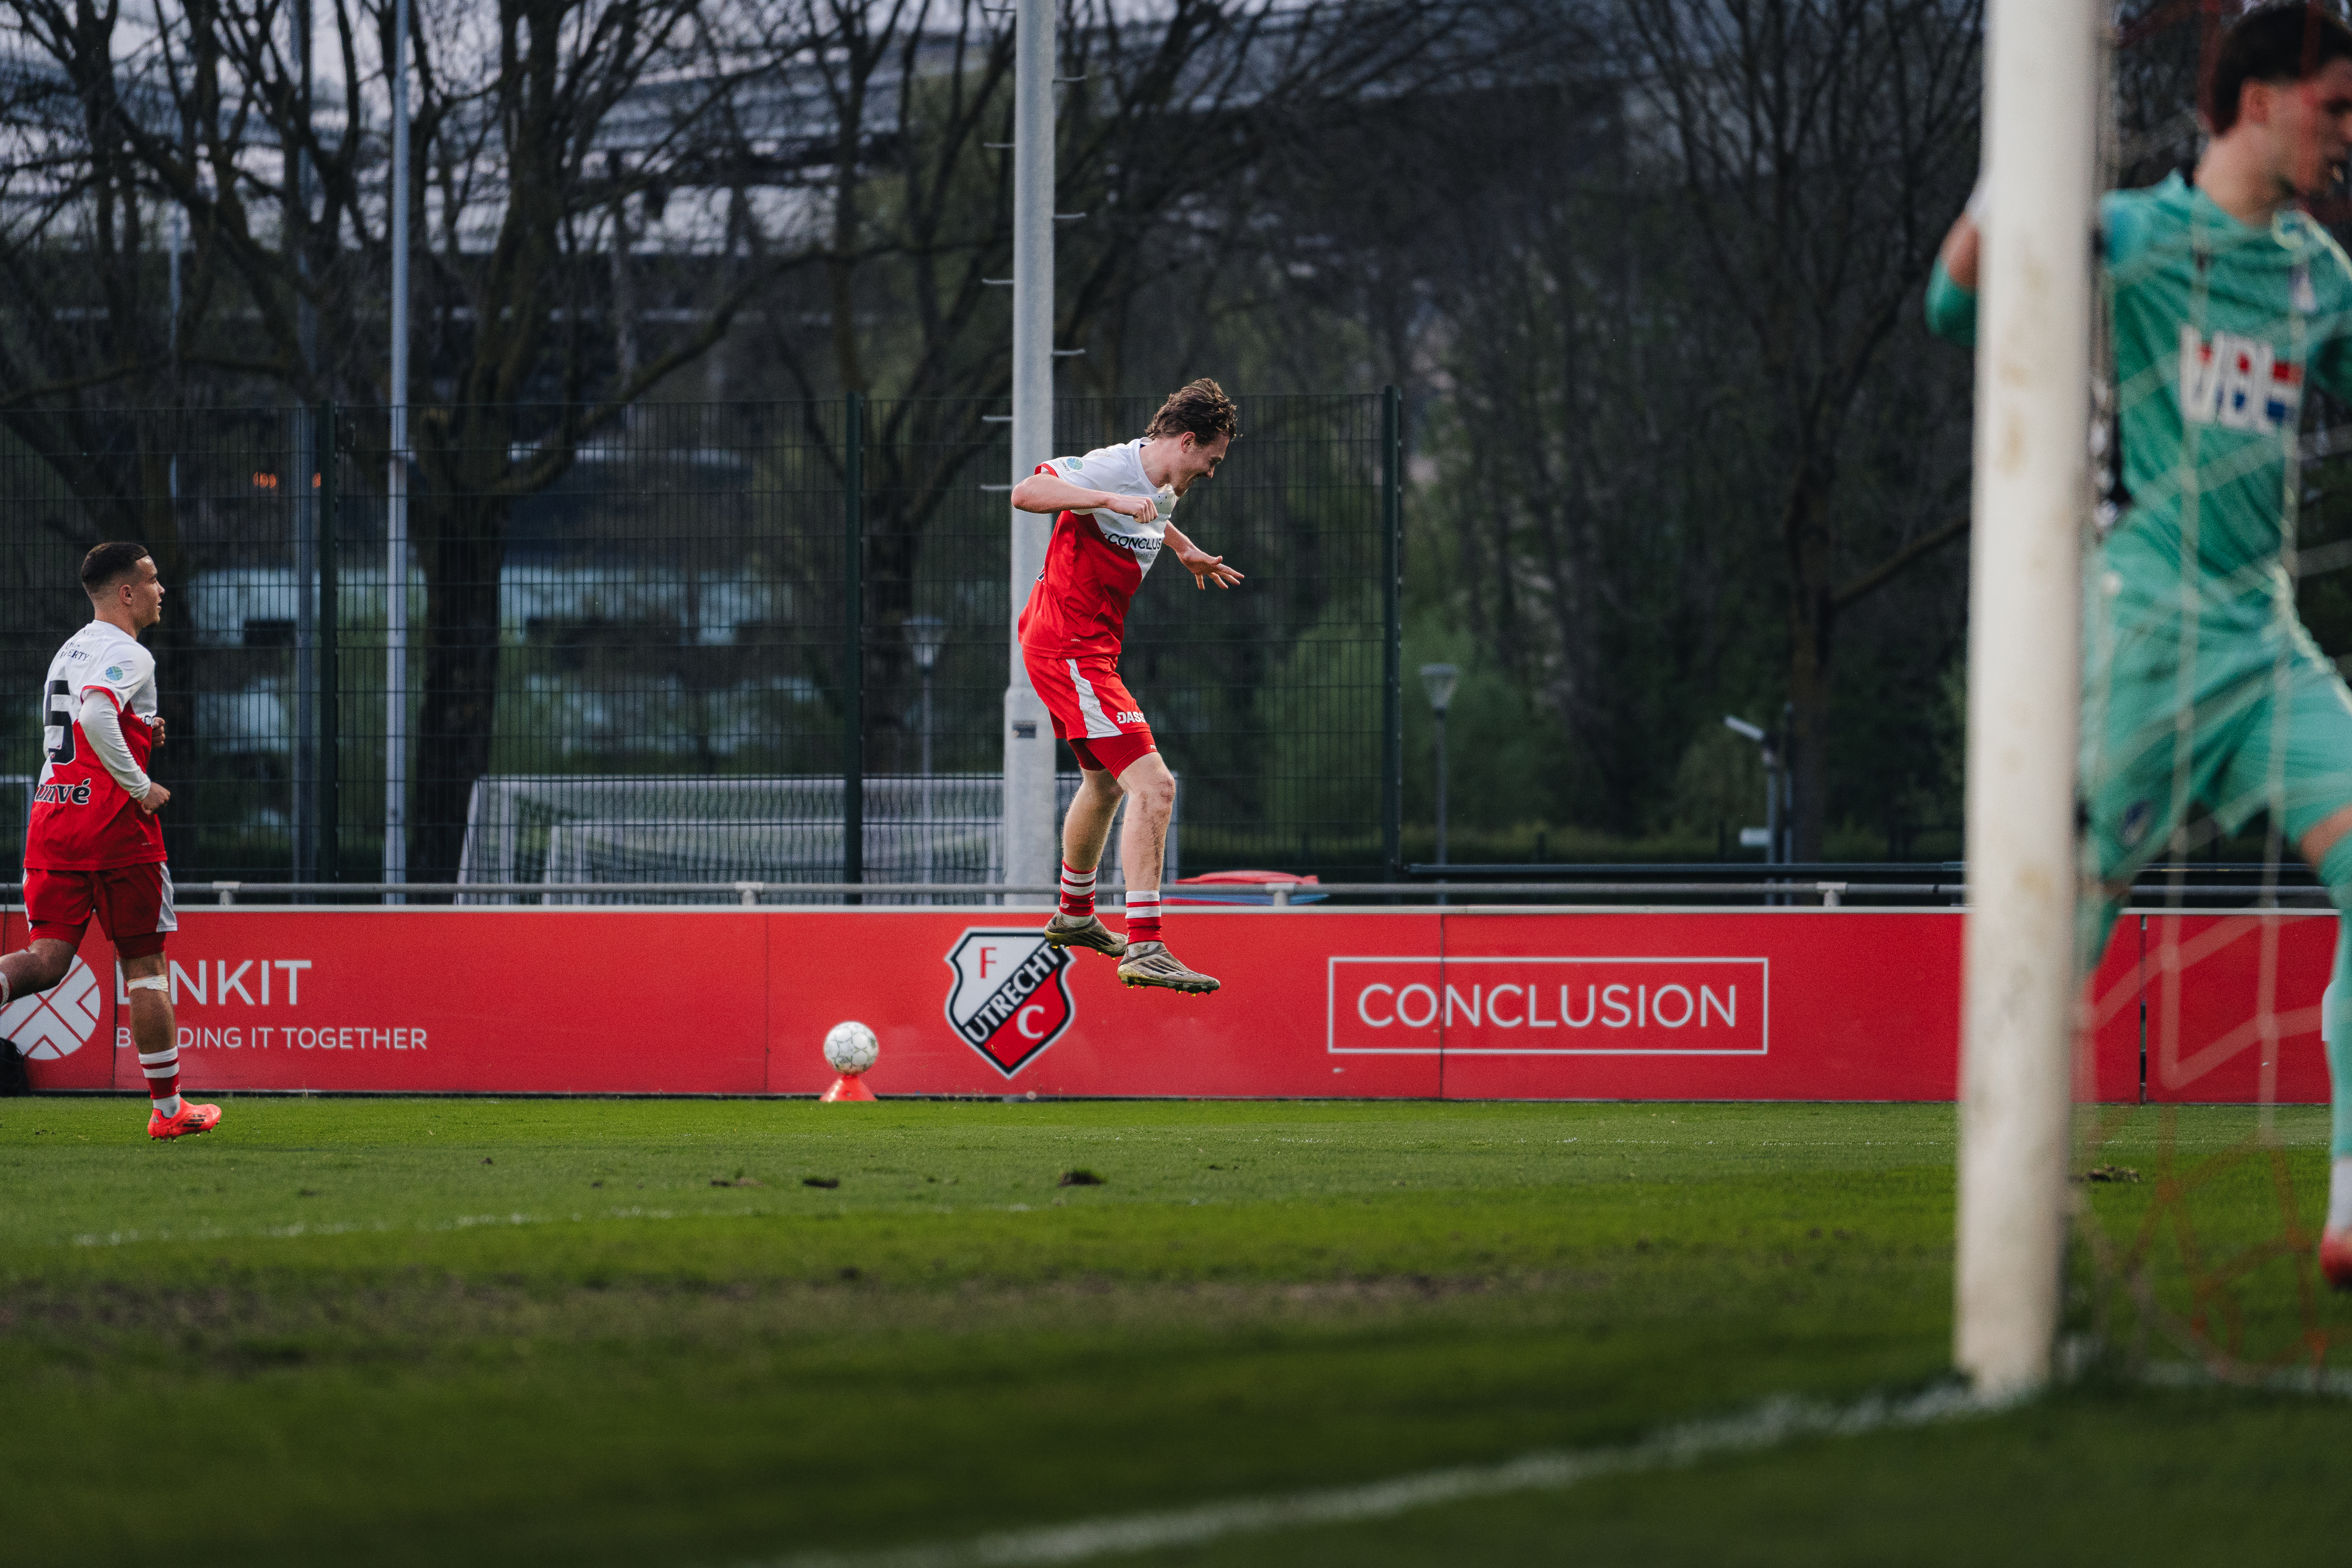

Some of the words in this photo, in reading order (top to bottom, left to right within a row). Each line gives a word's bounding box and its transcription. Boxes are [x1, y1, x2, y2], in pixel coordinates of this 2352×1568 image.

[1108, 533, 1163, 550] CONCLUS
[980, 946, 997, 979] F
[116, 960, 312, 1005] LNKIT
[964, 942, 1059, 1043] UTRECHT
[1017, 1005, 1045, 1039] C
[1357, 983, 1736, 1028] CONCLUSION
[116, 1027, 242, 1049] BDING
[251, 1027, 274, 1048] IT
[281, 1027, 428, 1049] TOGETHER
